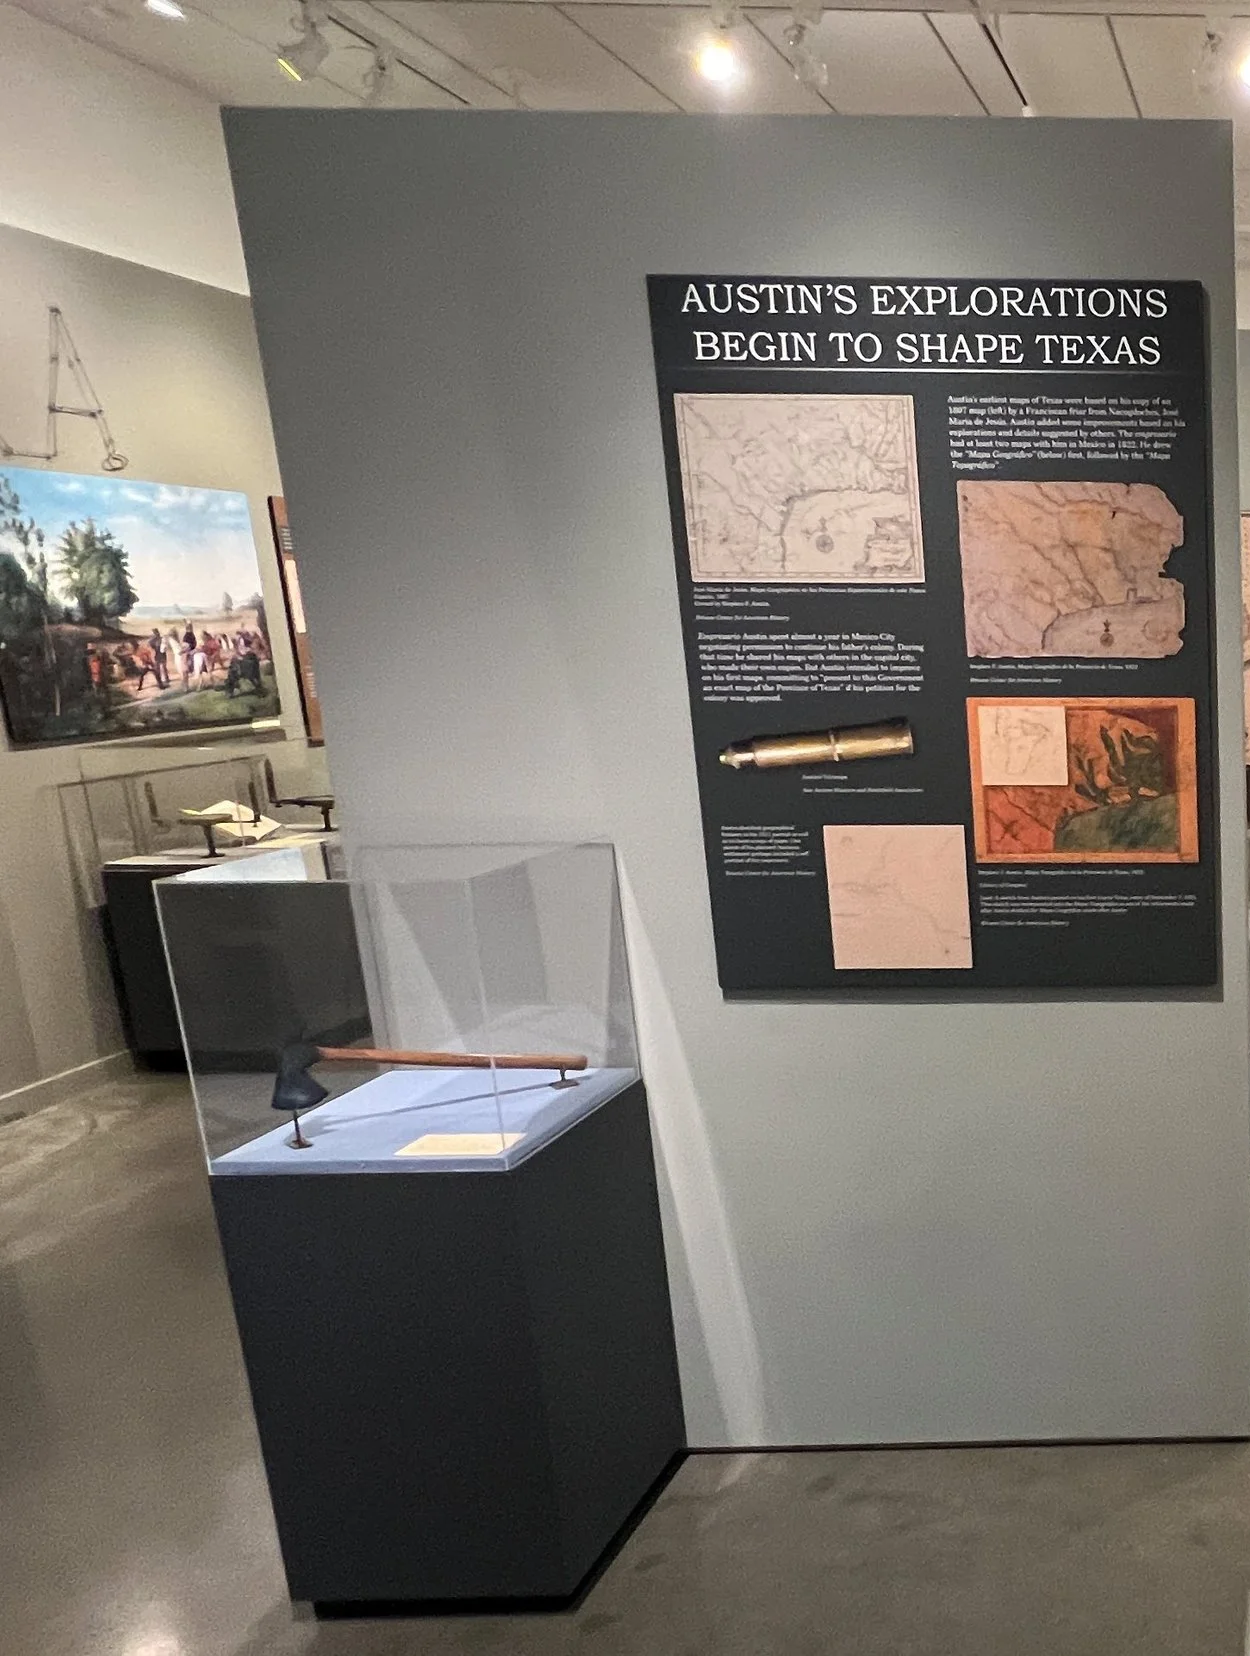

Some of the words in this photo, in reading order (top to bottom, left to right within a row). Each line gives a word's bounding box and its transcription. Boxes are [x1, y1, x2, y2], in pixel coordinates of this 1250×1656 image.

[681, 284, 857, 315] AUSTIN'S
[871, 285, 1168, 318] EXPLORATIONS
[694, 331, 816, 361] BEGIN
[829, 333, 881, 362] TO
[897, 333, 1024, 363] SHAPE
[1035, 334, 1160, 365] TEXAS
